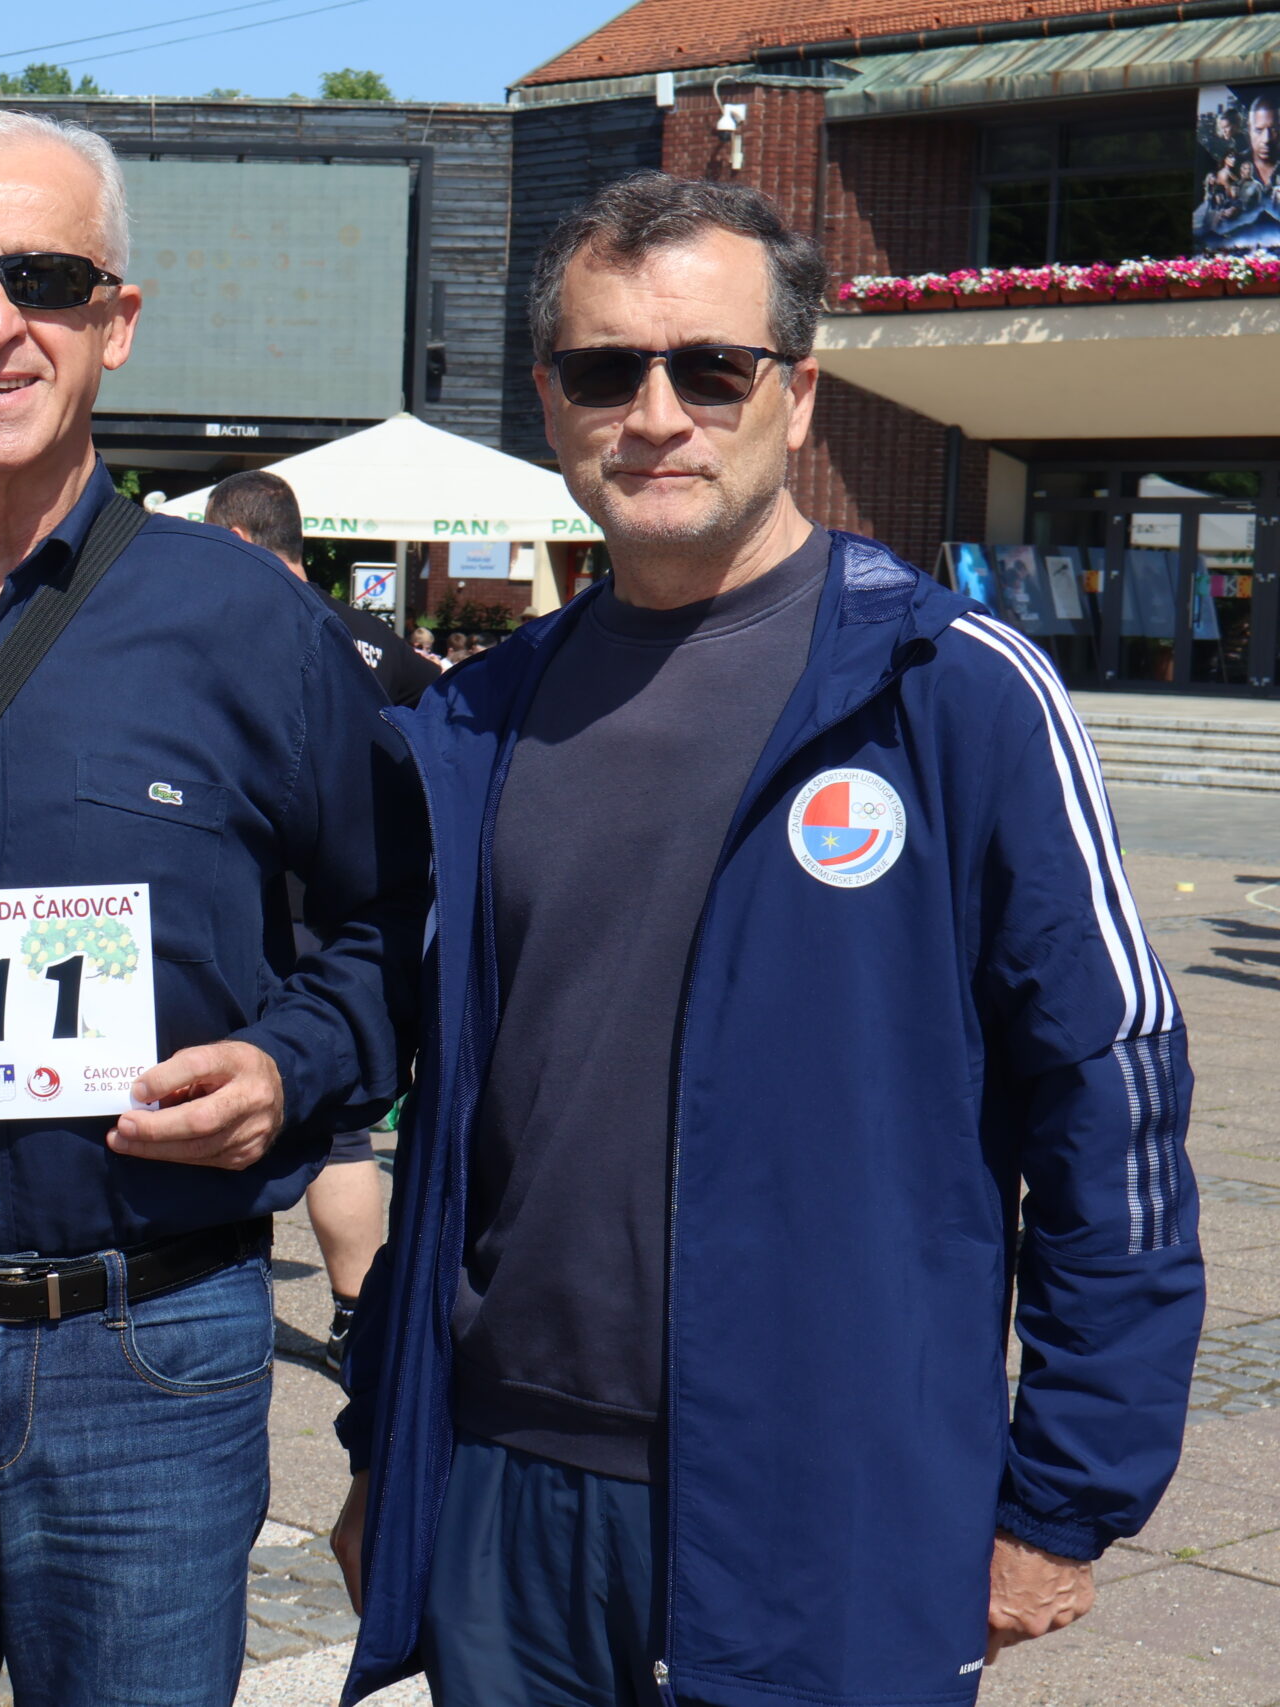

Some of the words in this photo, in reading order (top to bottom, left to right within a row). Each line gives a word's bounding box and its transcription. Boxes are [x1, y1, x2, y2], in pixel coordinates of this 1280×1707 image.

[220, 425, 260, 438] ACTUM
[303, 517, 358, 533] PAN
[433, 519, 490, 536] PAN
[792, 786, 816, 834] ZAJEDNICA
[860, 774, 894, 800] UDRUGA
[893, 804, 904, 839] SAVEZA
[32, 894, 134, 920] ČAKOVCA
[84, 1082, 132, 1092] 25.05.20
